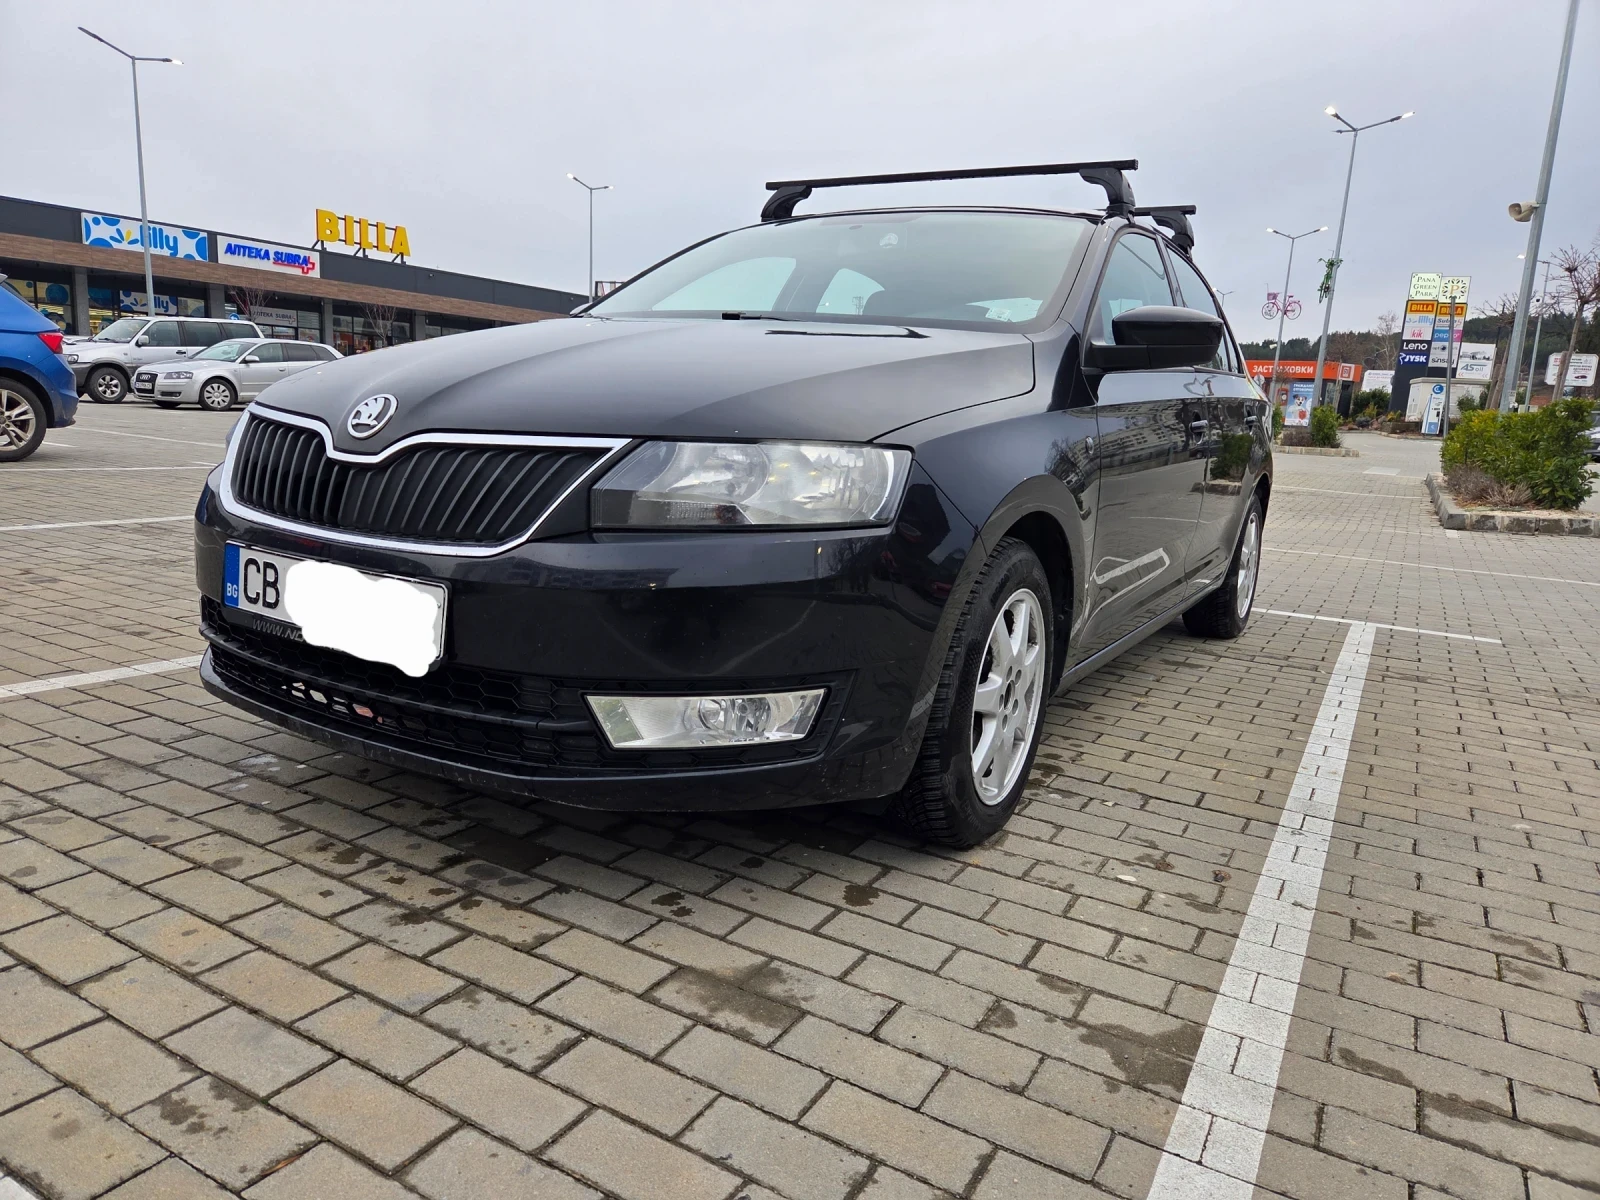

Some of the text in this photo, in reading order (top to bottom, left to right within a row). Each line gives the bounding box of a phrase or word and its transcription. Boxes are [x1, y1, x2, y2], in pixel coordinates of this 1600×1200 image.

[316, 209, 411, 257] BILLA
[224, 243, 309, 267] АПТЕКА SUBRA
[1403, 341, 1428, 350] Leno
[1404, 355, 1427, 363] JYSK
[1253, 365, 1313, 374] ЗАСТАХОВКИ
[226, 557, 280, 609] BG CB
